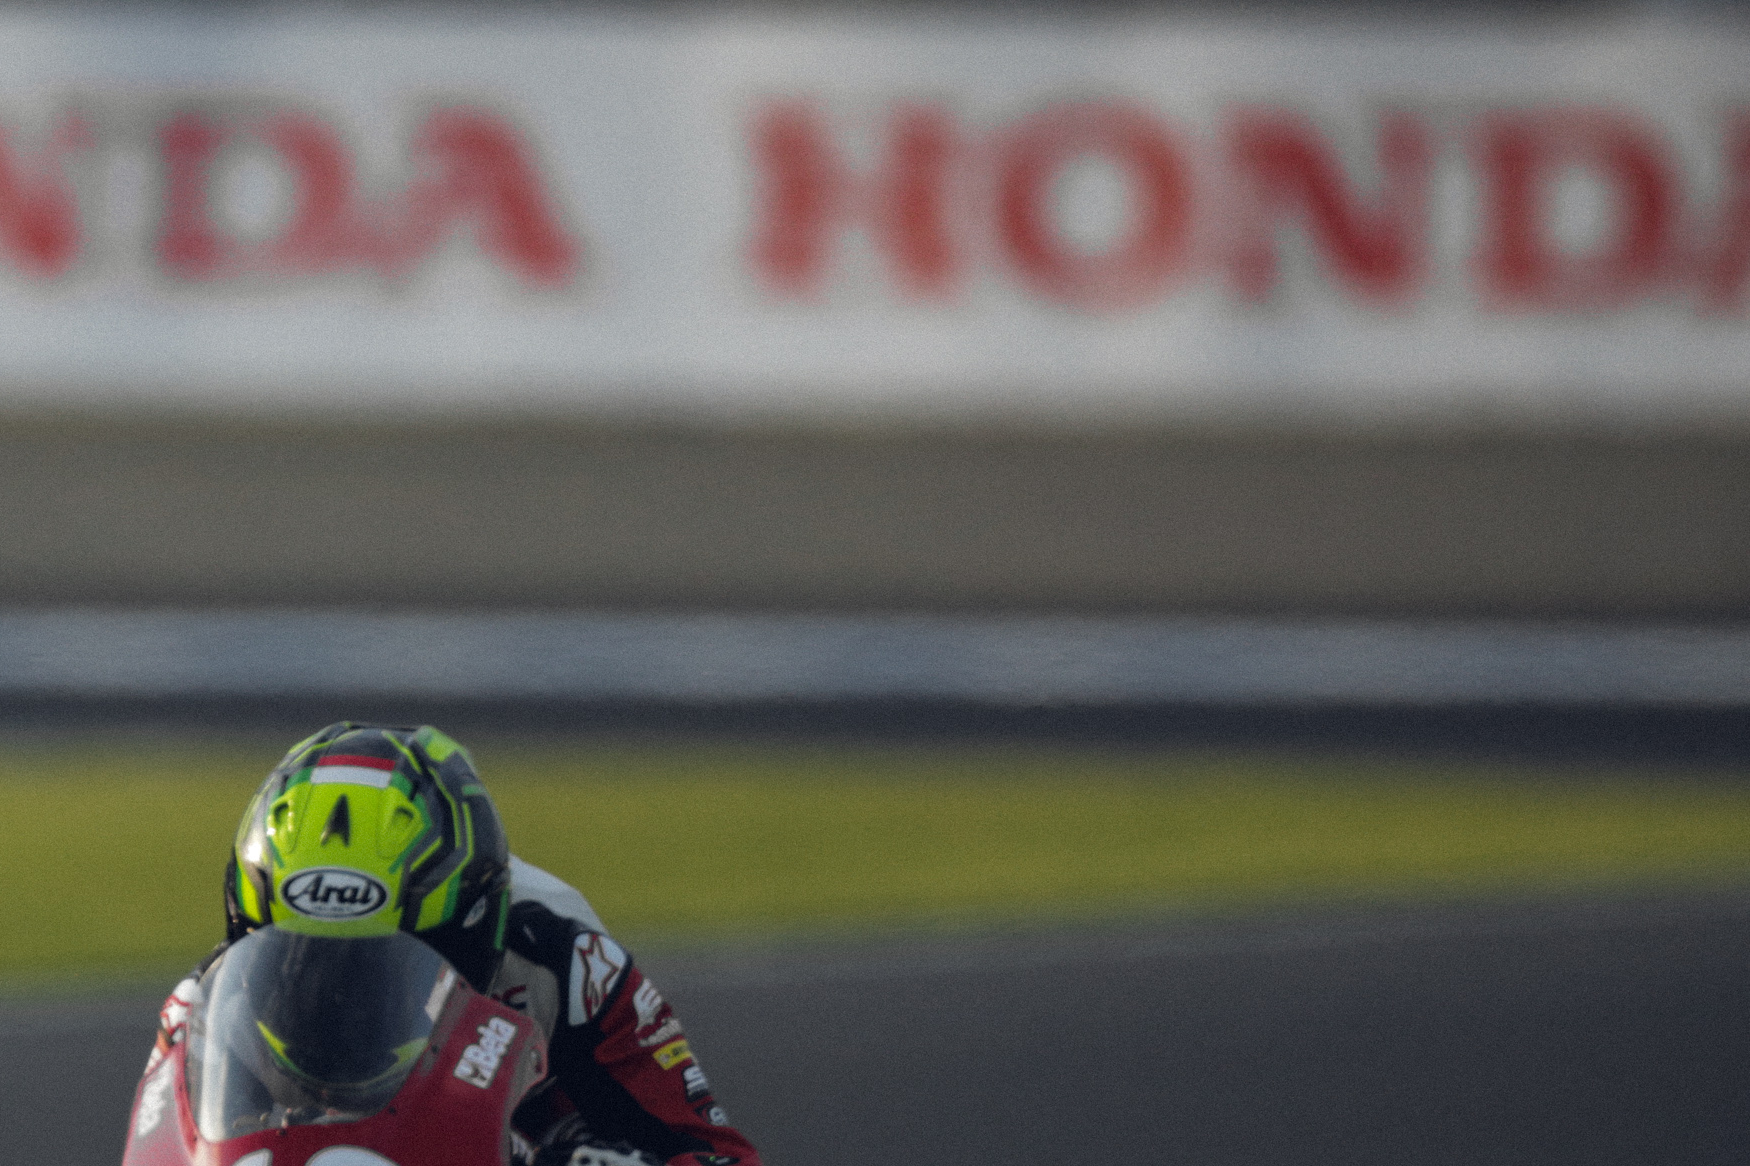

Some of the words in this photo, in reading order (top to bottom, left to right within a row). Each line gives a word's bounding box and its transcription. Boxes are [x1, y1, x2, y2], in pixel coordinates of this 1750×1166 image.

[740, 95, 1750, 315] HOND
[287, 872, 373, 905] Arai
[460, 1015, 518, 1073] Beta
